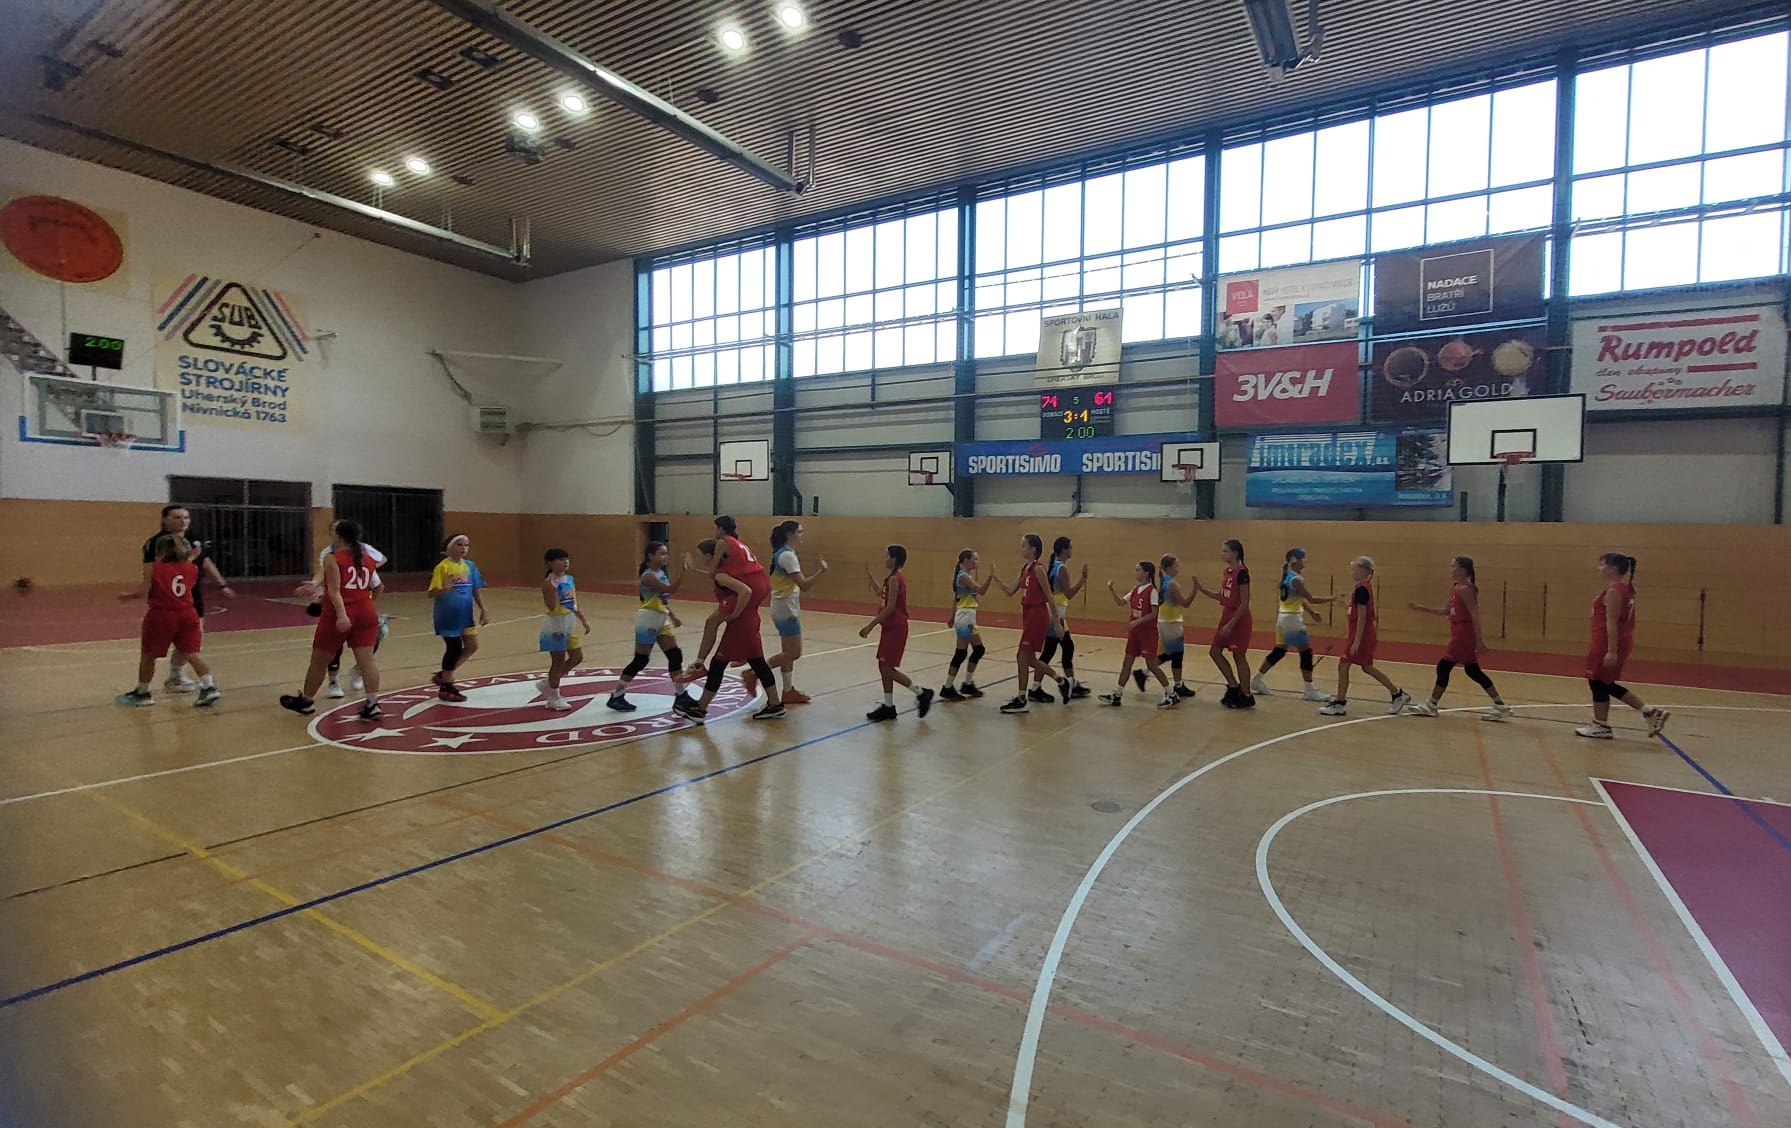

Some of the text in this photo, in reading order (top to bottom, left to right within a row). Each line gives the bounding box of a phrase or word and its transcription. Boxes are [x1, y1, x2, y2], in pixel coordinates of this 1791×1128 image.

[1427, 274, 1478, 290] NADACE
[210, 302, 262, 330] SUB
[1095, 311, 1120, 322] HALA
[1596, 328, 1760, 363] Rumpold
[179, 372, 290, 398] STROJÍRNY
[1233, 368, 1334, 402] 3V&H
[1594, 378, 1757, 402] Saubermacher
[251, 397, 287, 410] Brod
[1073, 396, 1079, 405] 5
[1094, 391, 1112, 405] 61
[255, 410, 287, 423] 1763
[1063, 409, 1088, 424] 3:1
[171, 574, 186, 597] 6
[344, 566, 370, 590] 20
